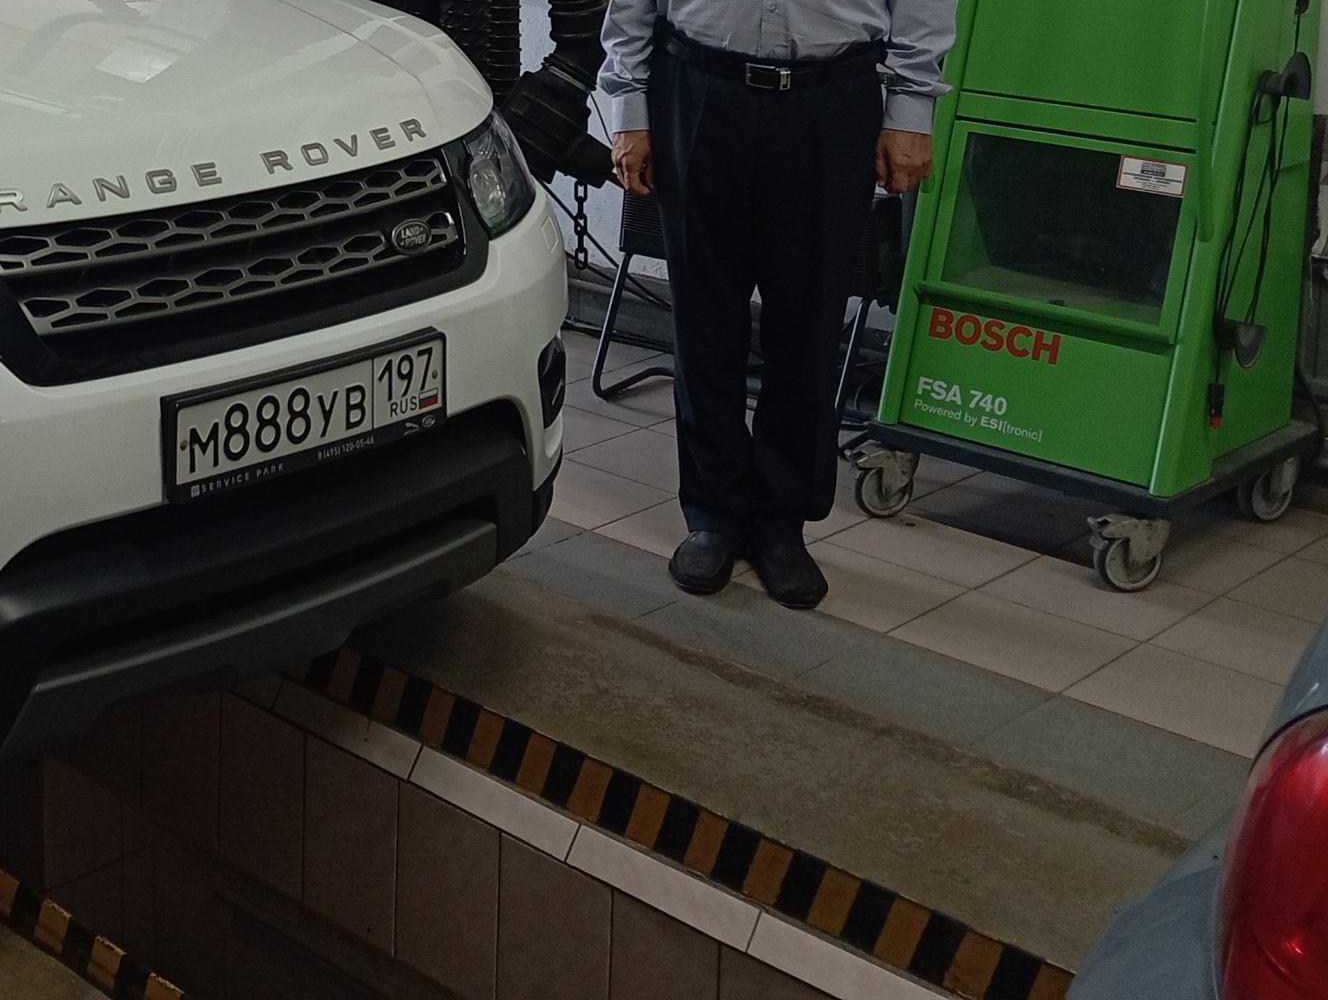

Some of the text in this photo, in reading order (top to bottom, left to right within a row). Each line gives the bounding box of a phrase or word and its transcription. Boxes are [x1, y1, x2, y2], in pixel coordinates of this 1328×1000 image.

[259, 118, 428, 175] ROVER
[928, 307, 1061, 365] BOSCH
[377, 346, 434, 402] 197
[389, 395, 418, 419] RUS
[913, 398, 962, 421] Powered
[964, 412, 978, 427] by
[916, 376, 1008, 416] FSA 740
[201, 462, 285, 494] SERVICE PARK
